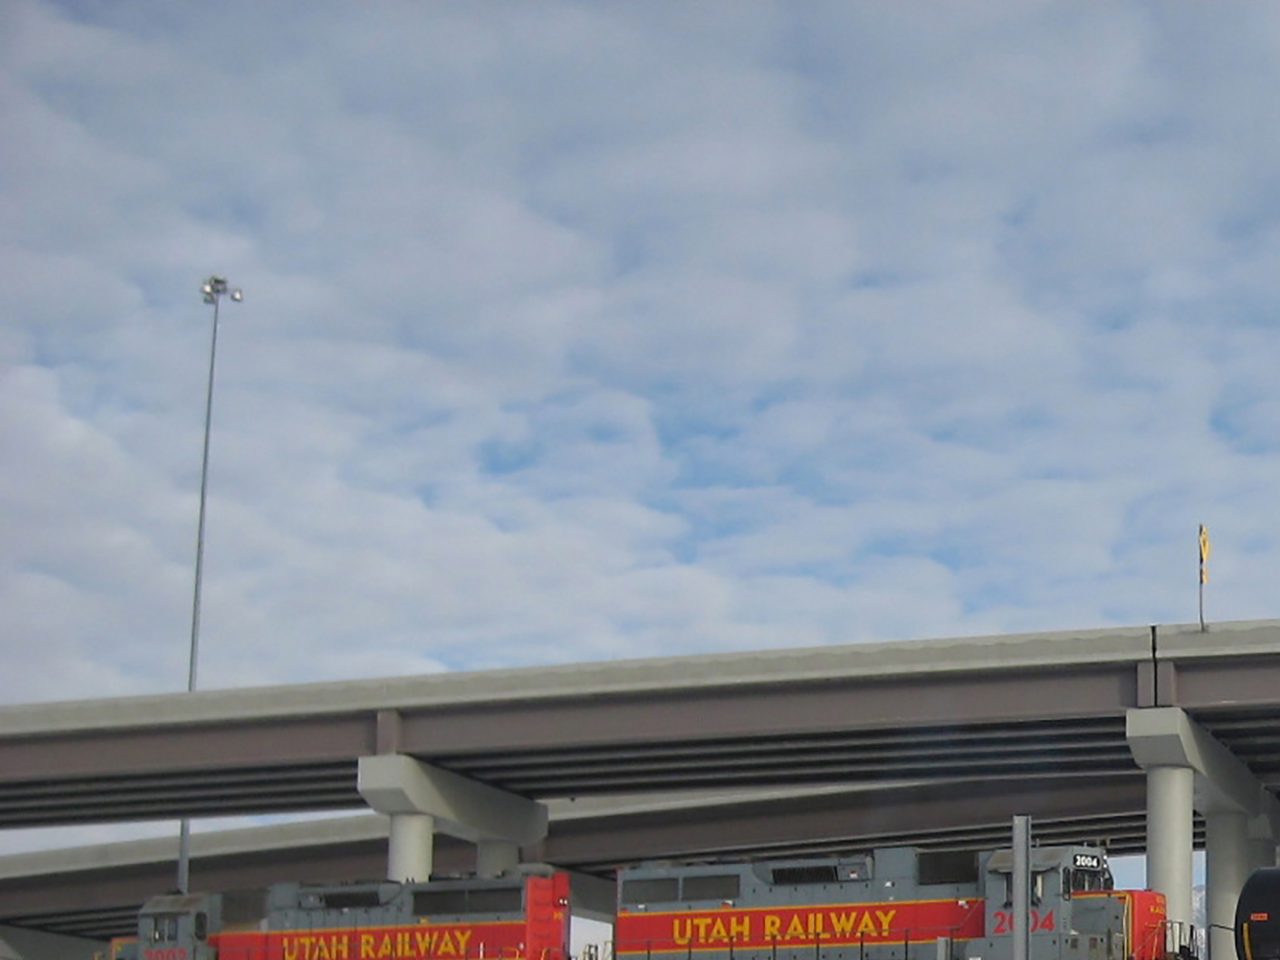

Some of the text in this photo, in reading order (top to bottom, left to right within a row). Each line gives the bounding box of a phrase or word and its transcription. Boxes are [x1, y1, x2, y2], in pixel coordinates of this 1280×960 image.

[1075, 853, 1099, 868] 2004
[672, 909, 897, 945] UTAH RAILWAY
[361, 929, 472, 960] RAILWAY
